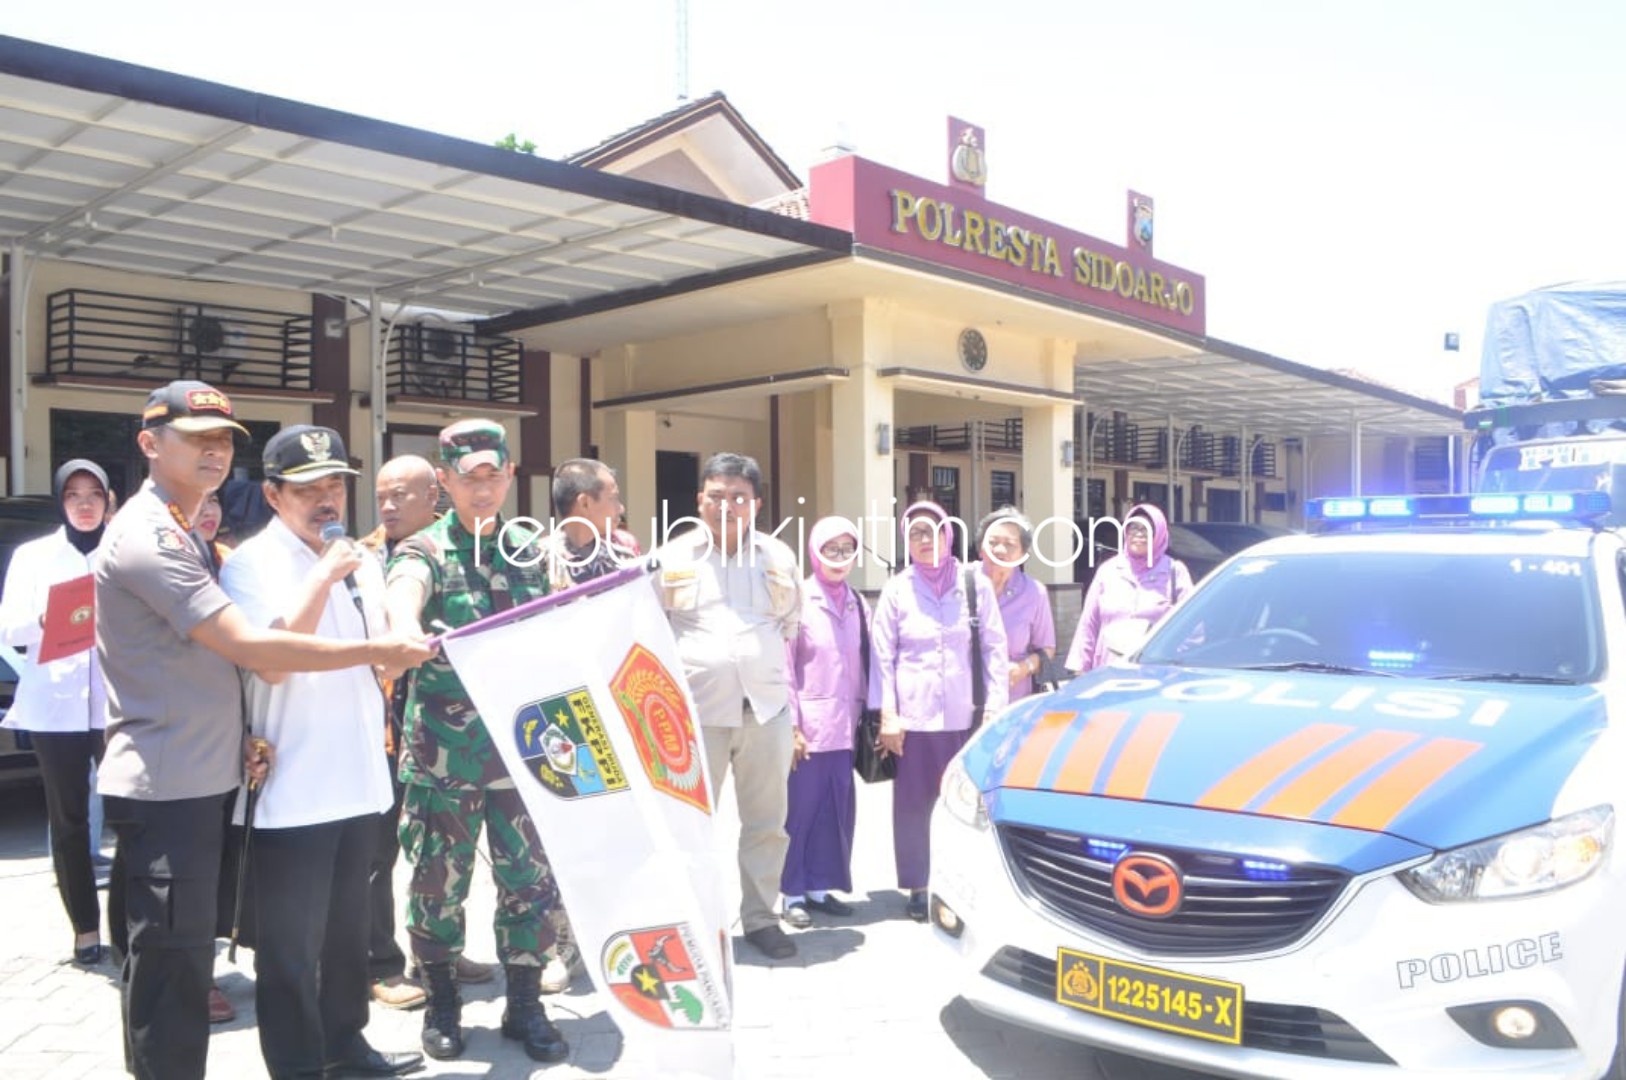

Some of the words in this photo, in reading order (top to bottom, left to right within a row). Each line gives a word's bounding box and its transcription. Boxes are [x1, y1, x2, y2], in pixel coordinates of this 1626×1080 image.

[890, 188, 1063, 276] POLRESTA
[1072, 246, 1194, 316] SIDOARJO
[653, 706, 680, 752] PPM
[1076, 678, 1510, 726] POLISI
[572, 698, 616, 784] FKPPI
[1396, 931, 1563, 989] POLICE
[1107, 974, 1233, 1027] 1225145-X
